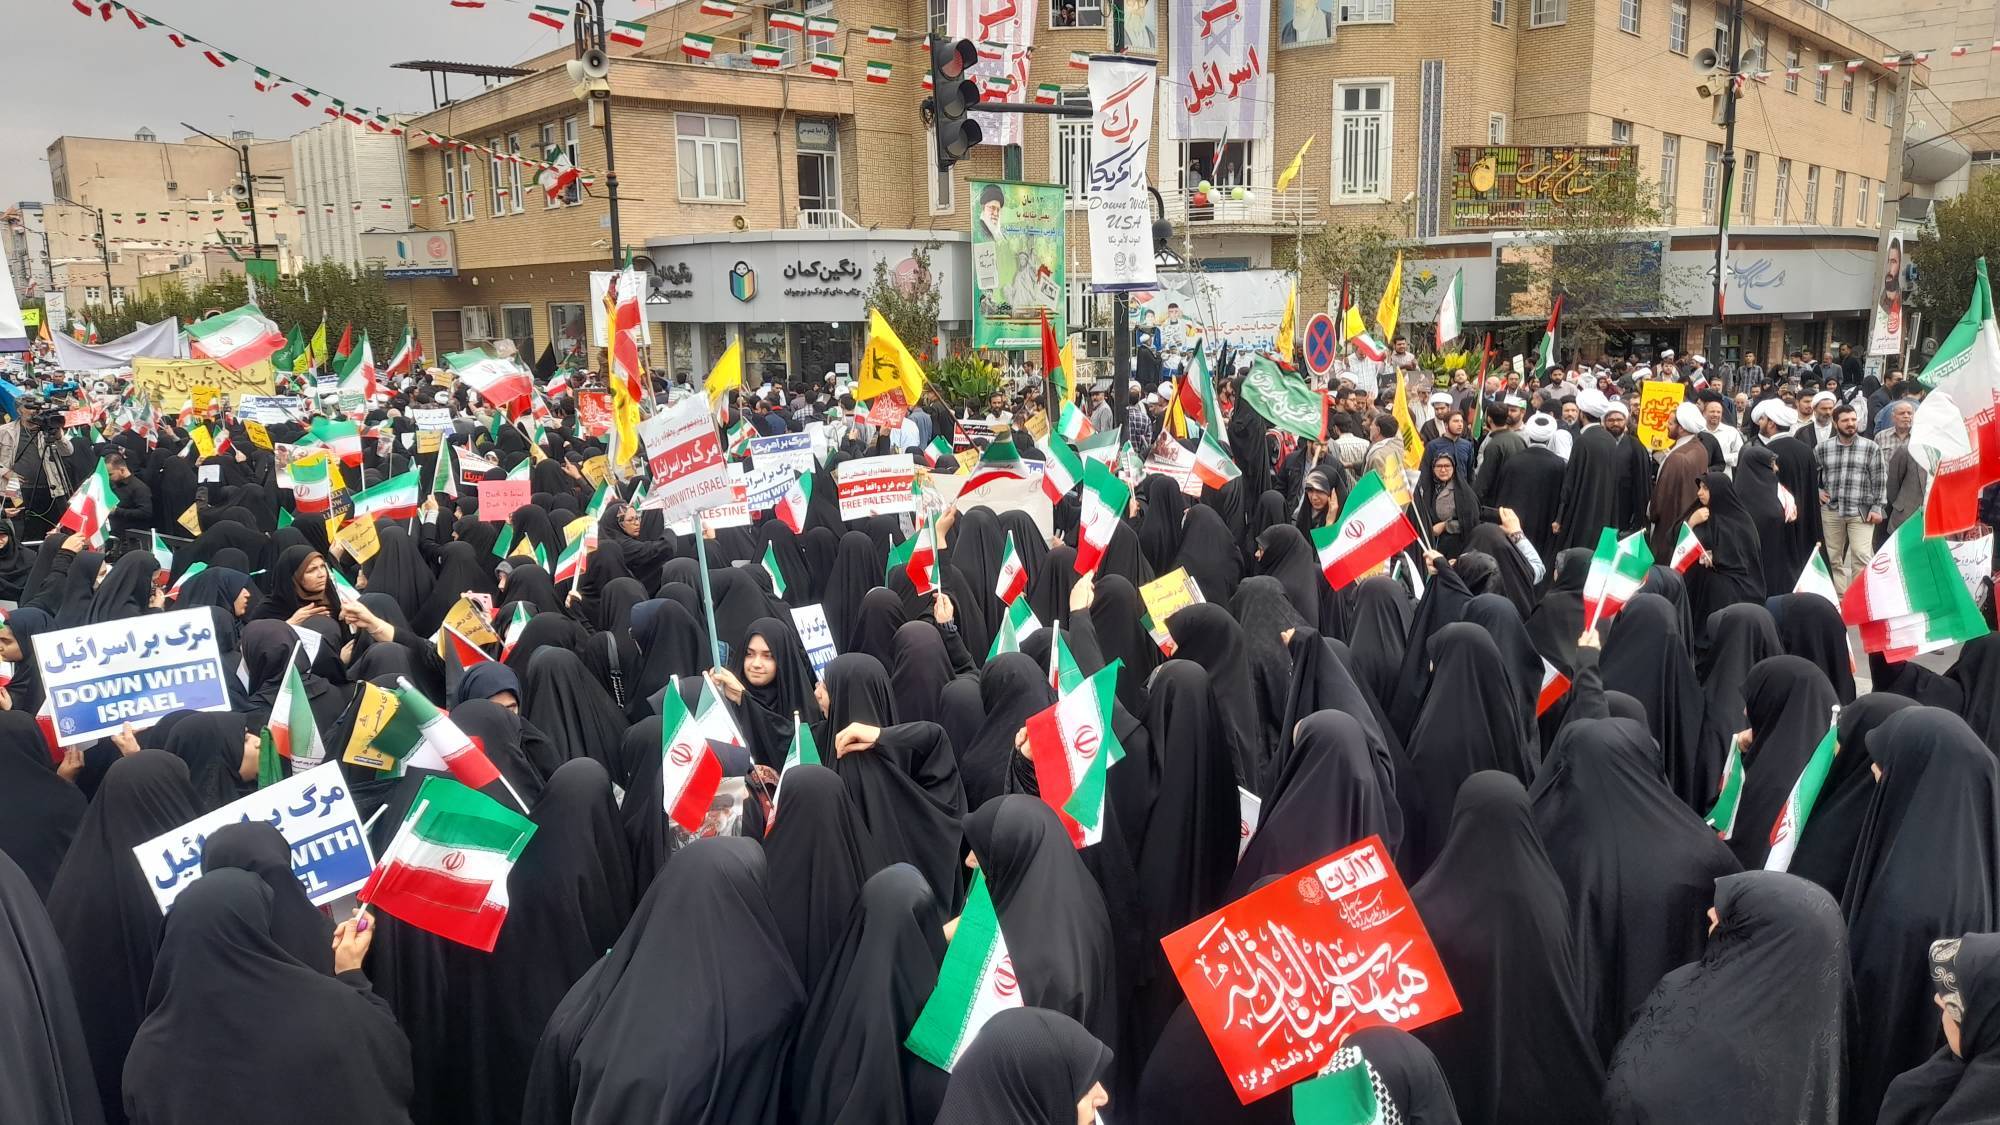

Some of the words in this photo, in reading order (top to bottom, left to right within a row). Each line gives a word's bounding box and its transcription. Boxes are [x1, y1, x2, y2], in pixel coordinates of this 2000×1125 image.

[1185, 45, 1260, 114] اسرائیل
[1099, 72, 1148, 143] مرگ
[1089, 196, 1126, 210] Down
[1106, 214, 1142, 230] USA
[680, 451, 693, 474] بر
[692, 439, 719, 465] مرگ
[697, 476, 728, 498] ISRAEL
[748, 489, 771, 503] OWN
[841, 499, 863, 511] FREE
[863, 493, 913, 506] PALESTINE
[139, 631, 160, 659] بر
[165, 622, 212, 651] مرگ
[45, 630, 137, 674] اسرائیل
[54, 674, 143, 709] DOWN
[144, 661, 217, 691] WITH
[97, 691, 185, 724] ISRAEL
[288, 783, 346, 818] مرگ
[1325, 855, 1361, 892] آبان
[1308, 1040, 1325, 1055] ما
